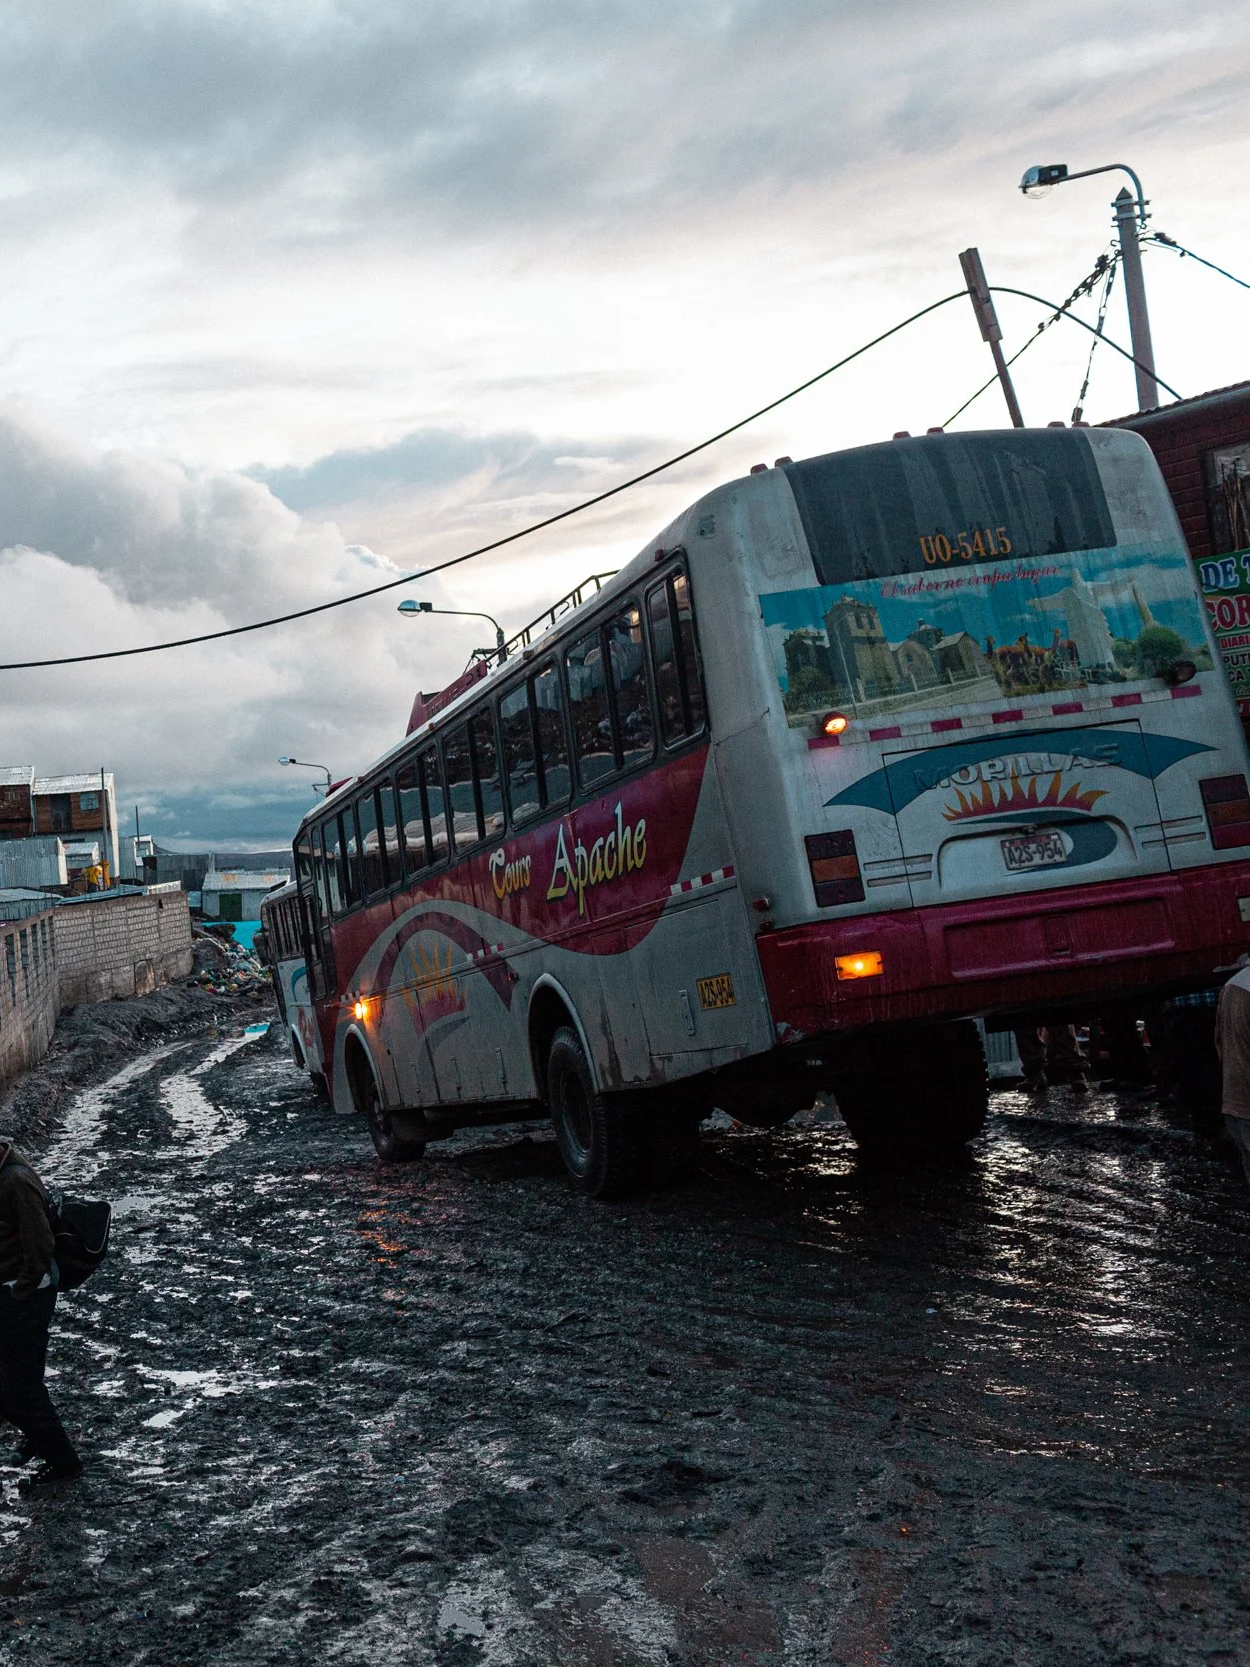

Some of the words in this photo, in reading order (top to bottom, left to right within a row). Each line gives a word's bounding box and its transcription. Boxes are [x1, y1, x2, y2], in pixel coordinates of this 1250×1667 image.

[919, 527, 1012, 564] UO-5415
[1200, 557, 1240, 593] DE
[547, 800, 647, 917] Apache
[1007, 840, 1063, 866] A2S-954
